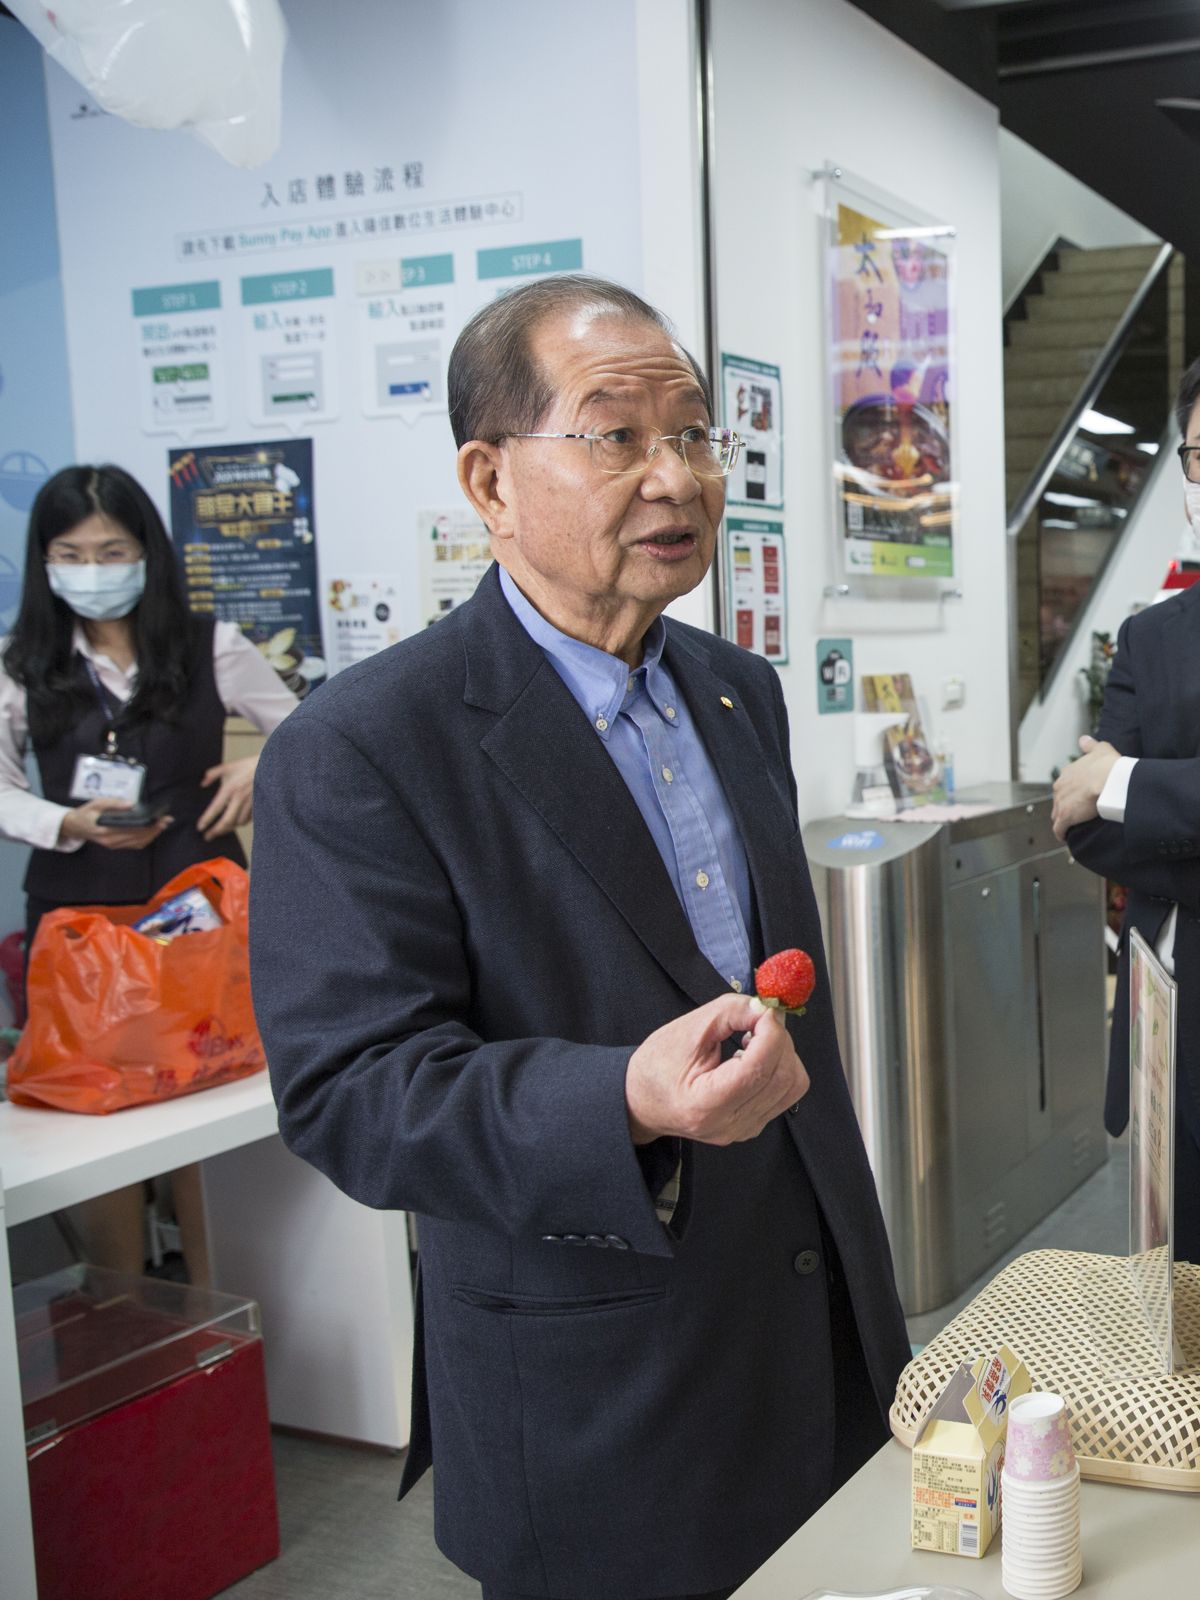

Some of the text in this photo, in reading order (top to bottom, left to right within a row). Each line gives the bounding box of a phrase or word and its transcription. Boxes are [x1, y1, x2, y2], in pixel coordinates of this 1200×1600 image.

[259, 161, 425, 208] 入店體驗流程
